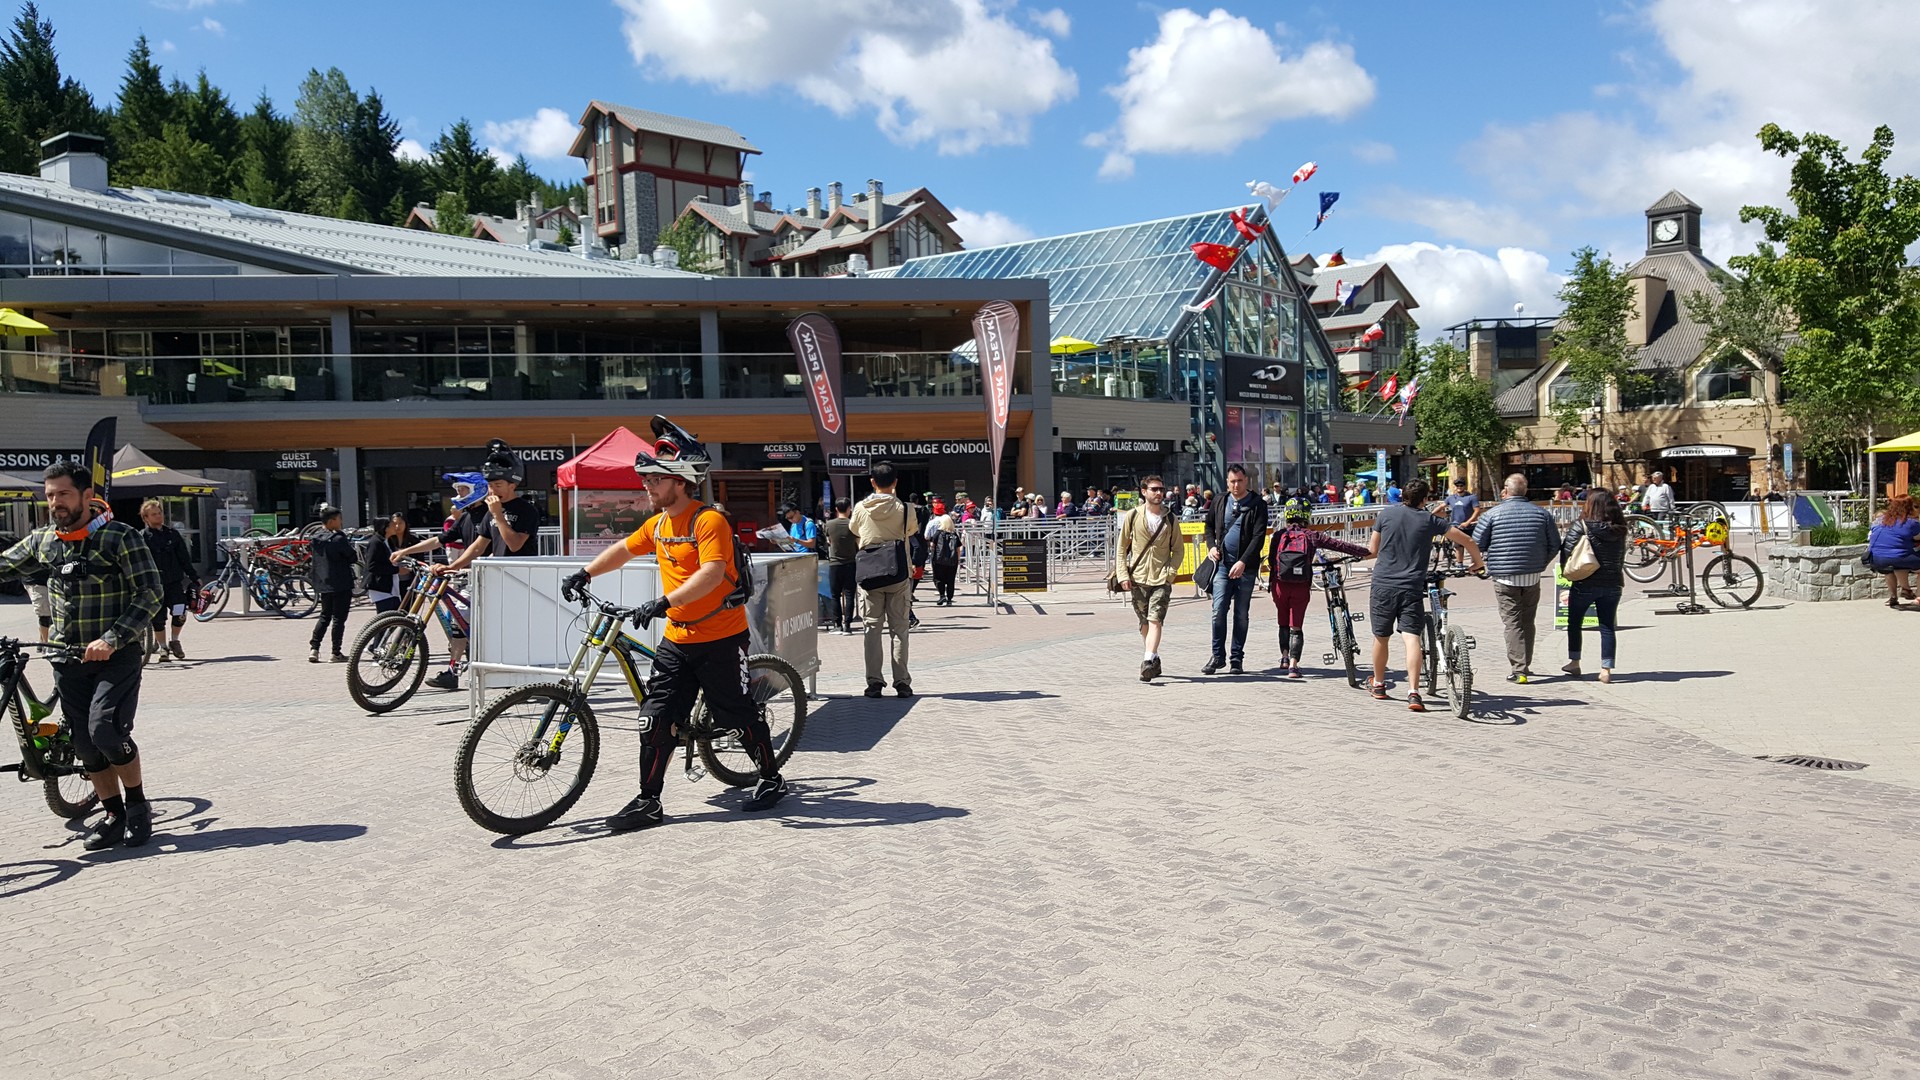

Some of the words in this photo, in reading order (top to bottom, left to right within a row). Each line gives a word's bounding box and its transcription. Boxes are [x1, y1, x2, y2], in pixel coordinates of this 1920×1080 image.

[763, 444, 794, 452] ACCESS
[846, 444, 887, 456] ISTLER
[890, 443, 939, 455] VILLAGE
[942, 442, 991, 454] GONDOL
[1076, 440, 1108, 451] WHISTLER
[1108, 441, 1132, 451] VILLAGE
[1133, 442, 1160, 452] GONDOLA
[0, 453, 50, 467] SSONS
[281, 452, 311, 461] GUEST
[512, 449, 565, 461] TICKETS
[276, 460, 318, 469] SERVICES
[831, 457, 867, 467] ENTRANCE
[782, 619, 790, 639] NO
[790, 610, 813, 635] SMOKING
[7, 695, 29, 748] SPECIALIZ
